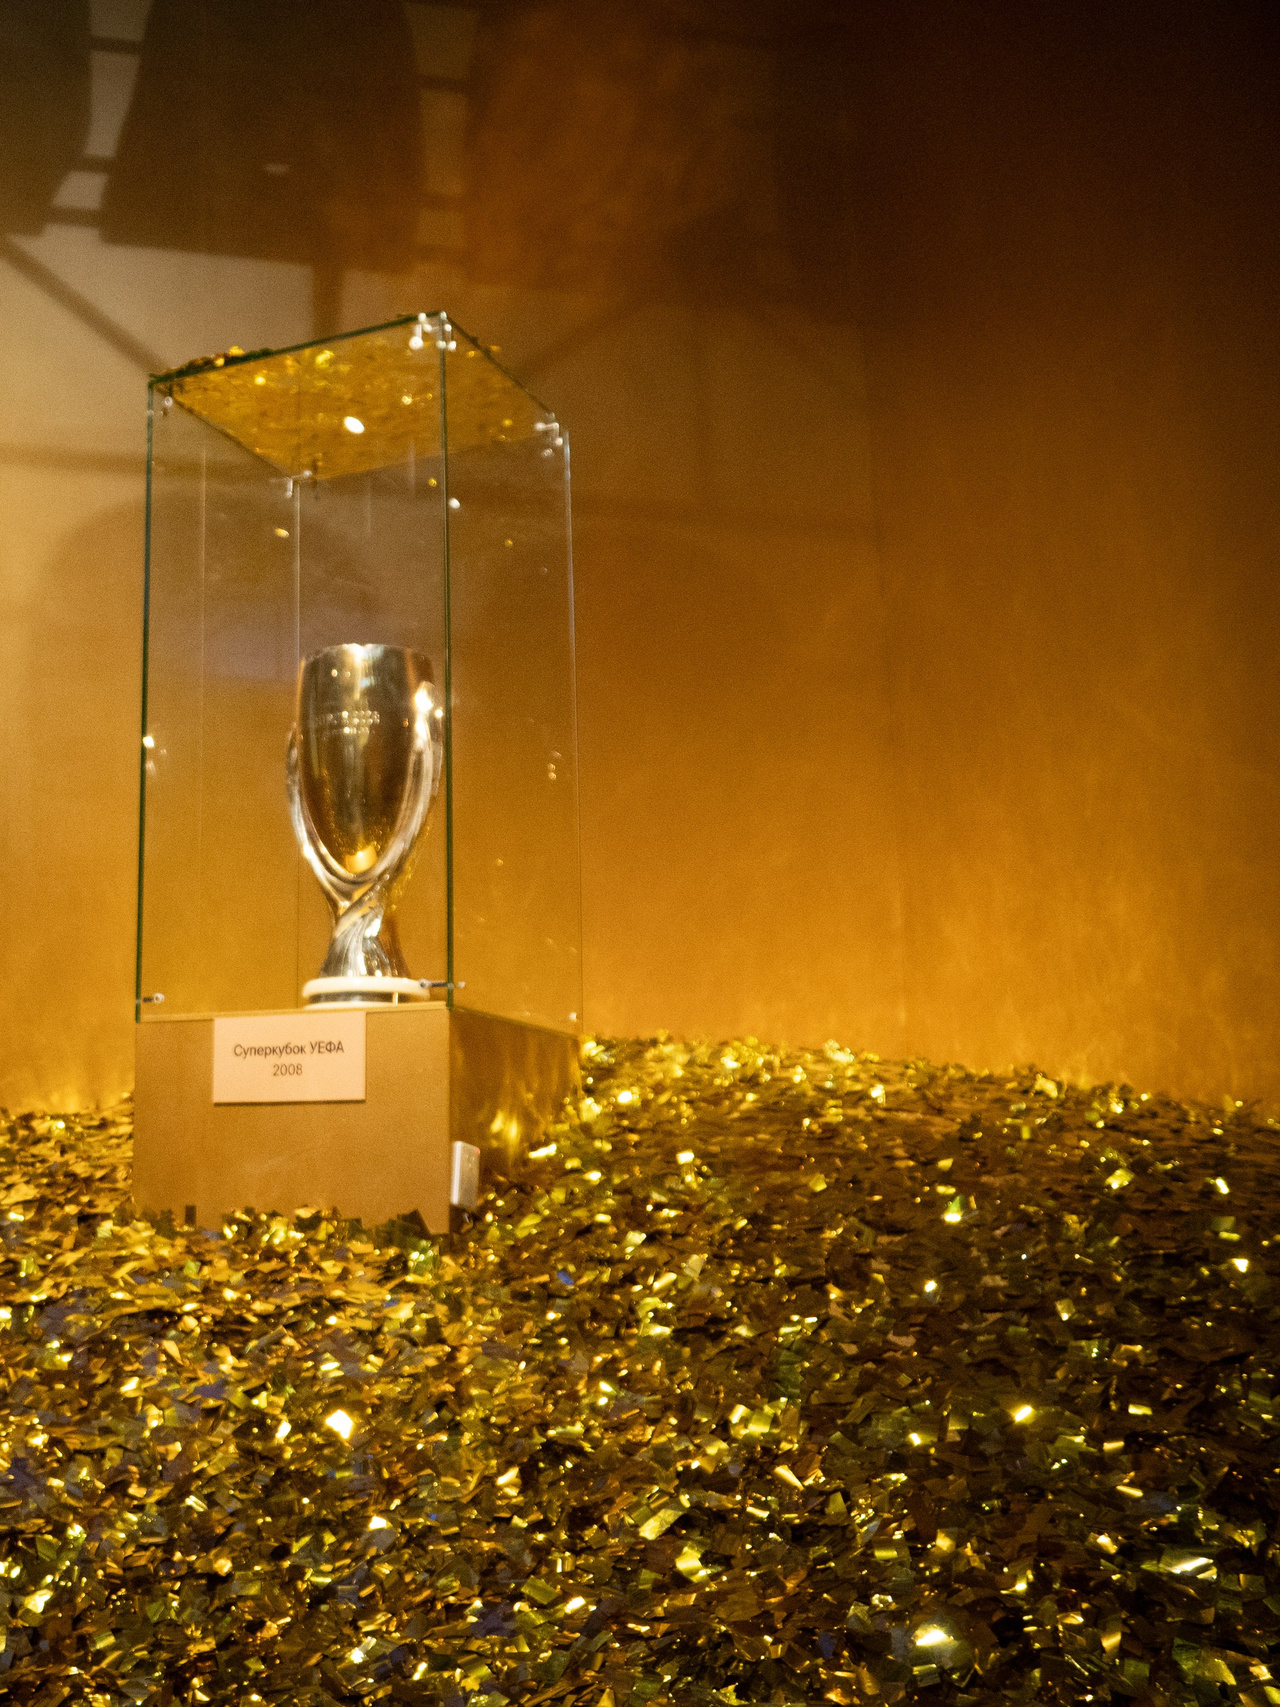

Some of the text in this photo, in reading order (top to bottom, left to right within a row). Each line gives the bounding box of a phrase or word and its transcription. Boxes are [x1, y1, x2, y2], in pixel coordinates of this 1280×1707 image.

[233, 1040, 345, 1060] Суперкубок УЕФА
[272, 1063, 304, 1077] 2008
